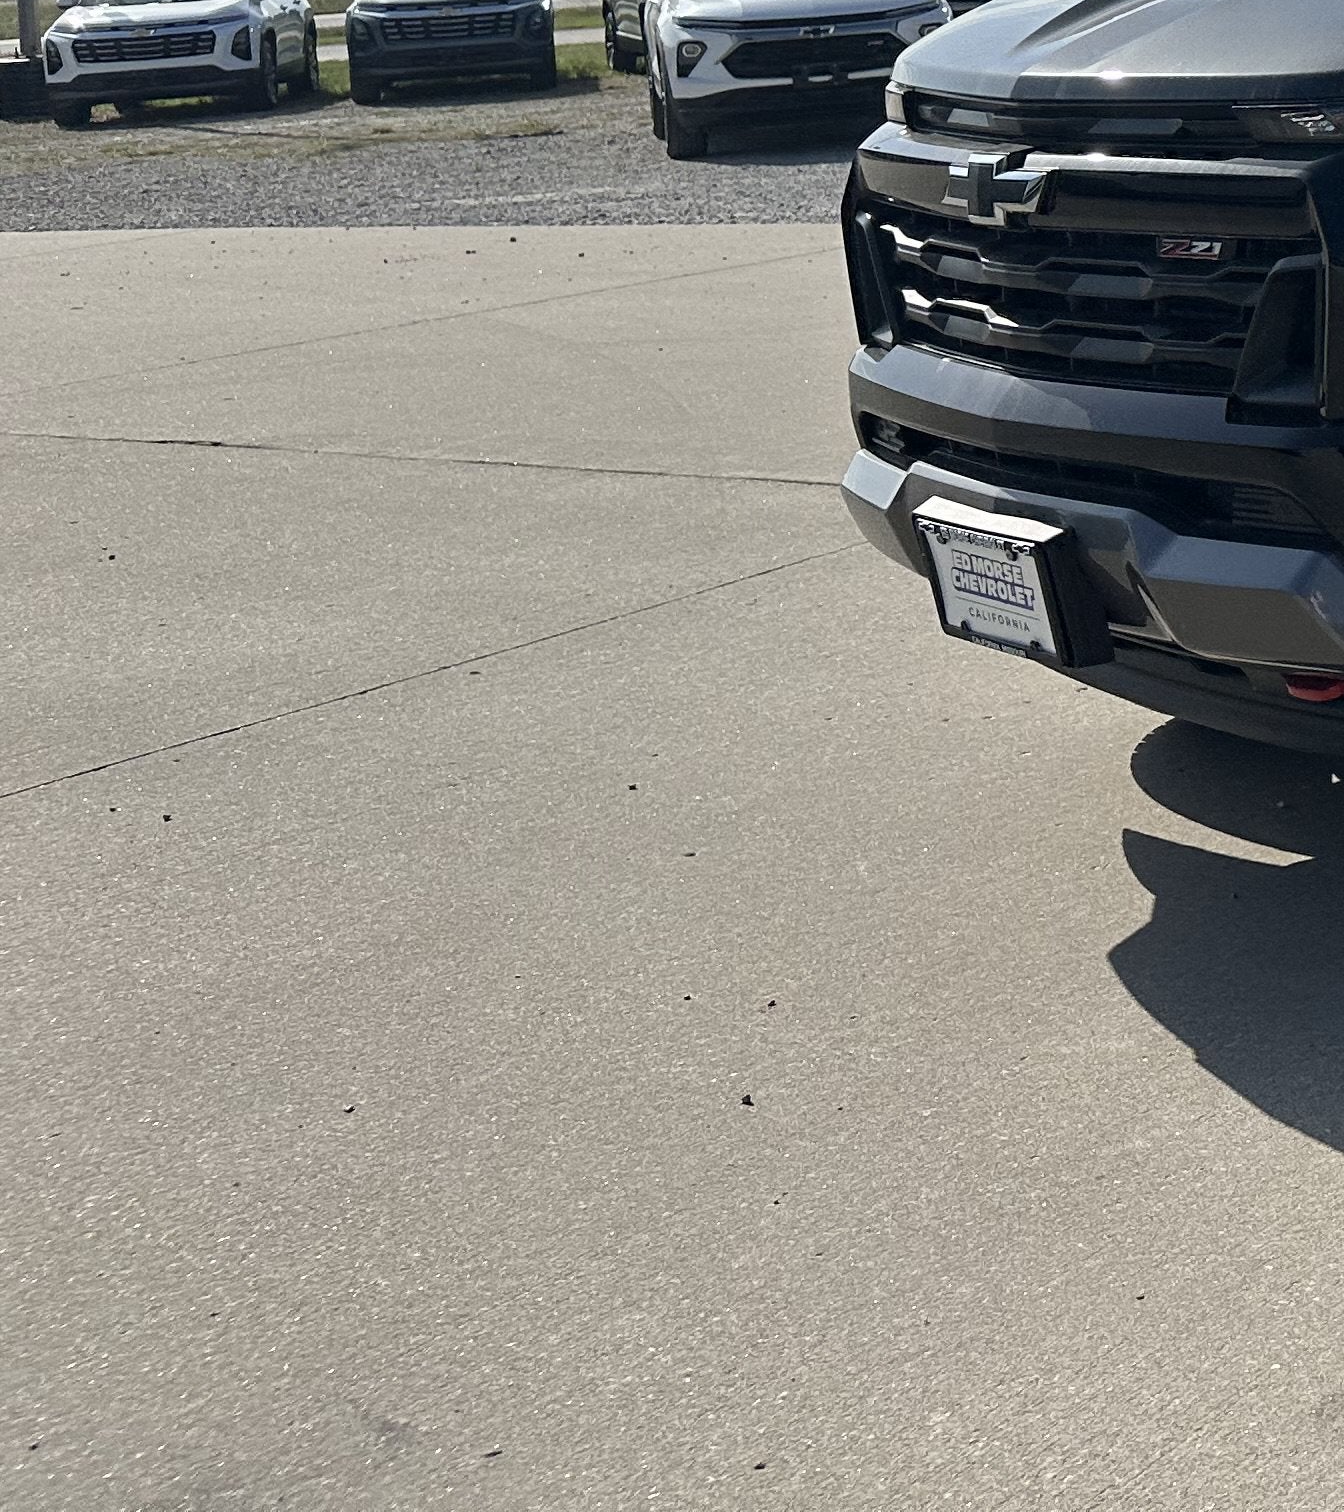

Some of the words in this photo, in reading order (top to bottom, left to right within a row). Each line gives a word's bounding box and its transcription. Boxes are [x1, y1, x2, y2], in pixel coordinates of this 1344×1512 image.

[1160, 239, 1222, 260] Z71
[952, 549, 971, 569] ED
[971, 555, 1023, 584] MORSE
[952, 567, 1034, 610] CHEVROLET
[968, 607, 1030, 632] CALIFORNIA
